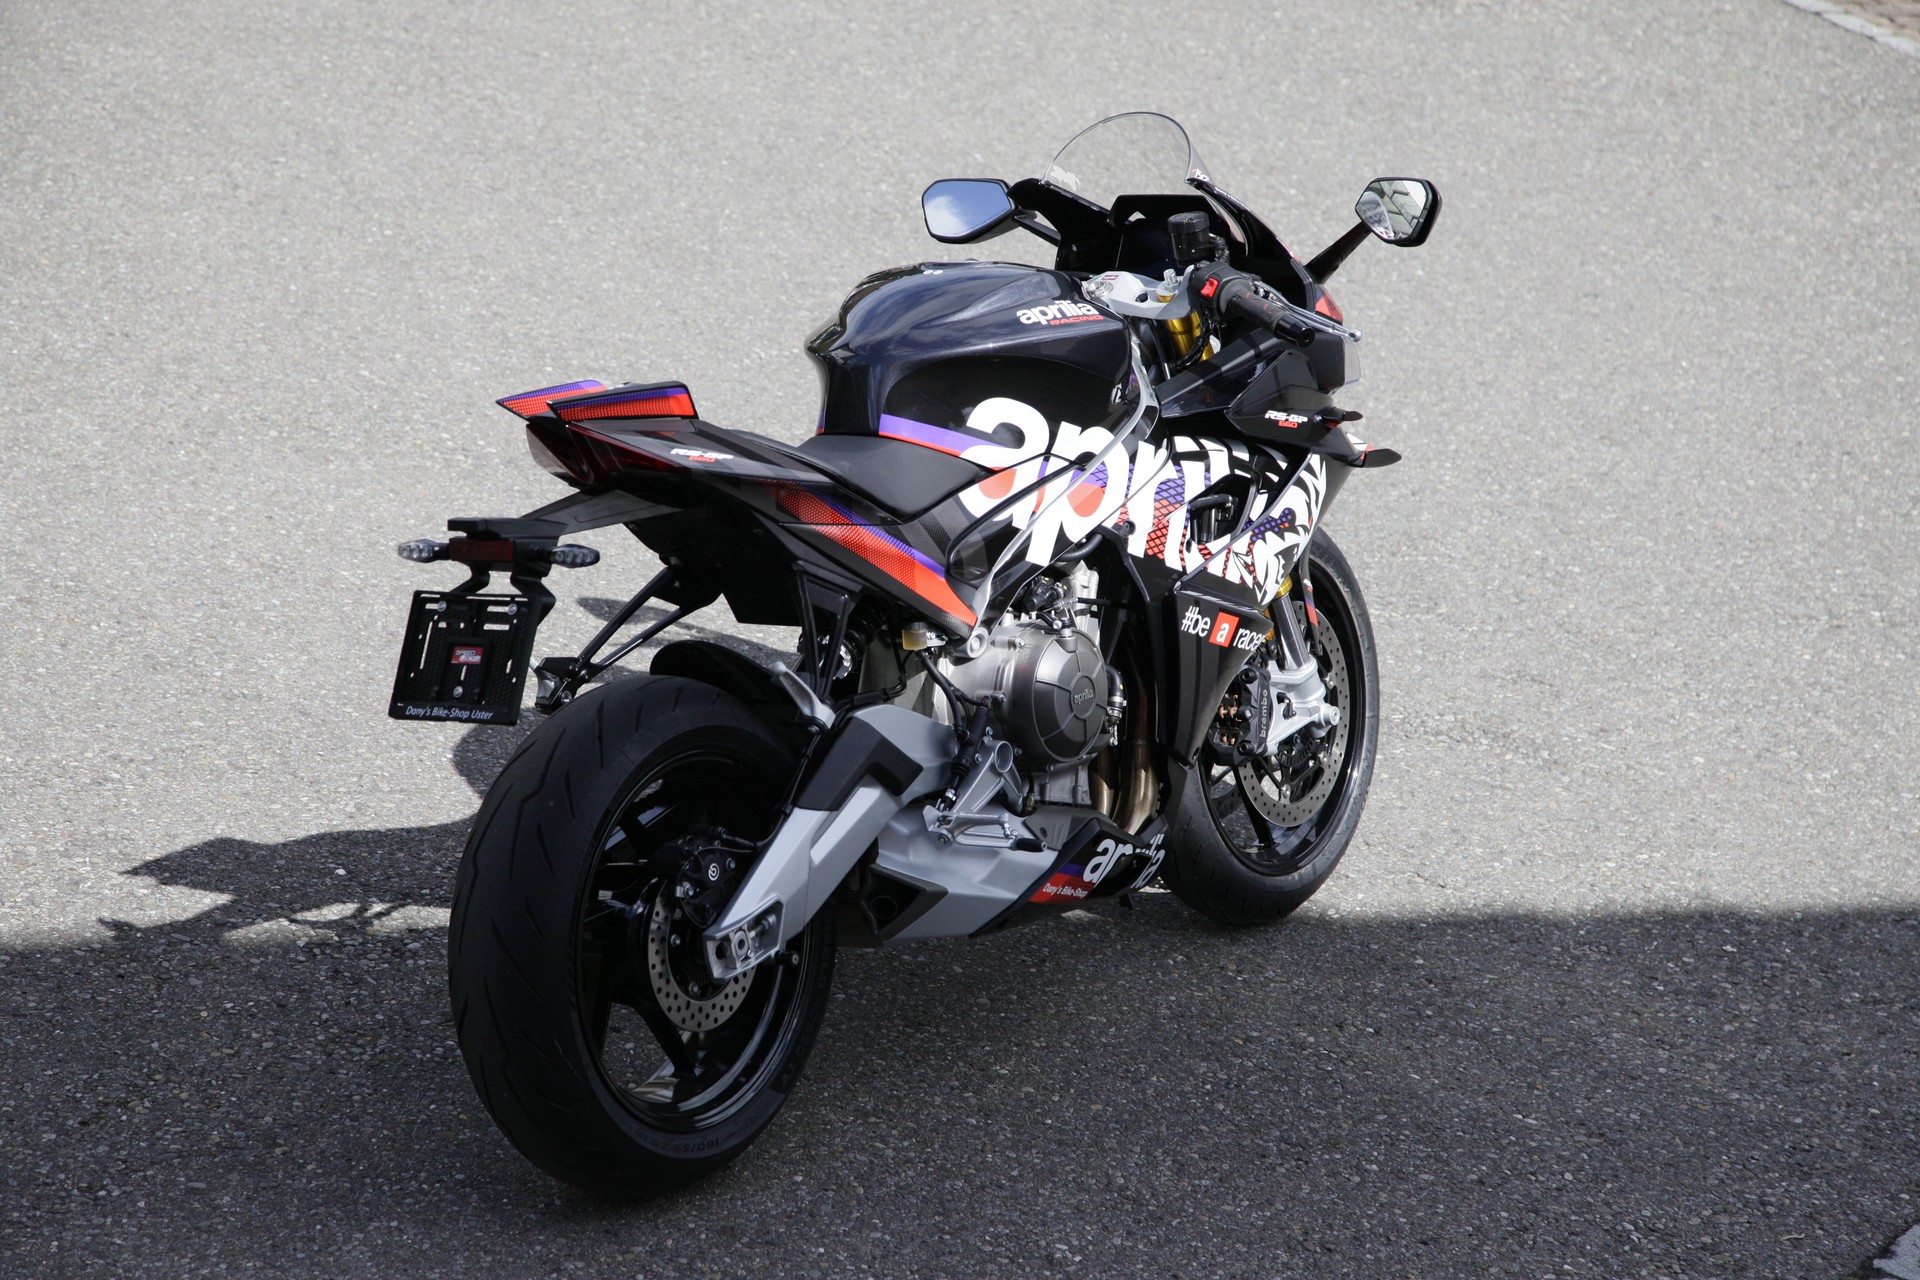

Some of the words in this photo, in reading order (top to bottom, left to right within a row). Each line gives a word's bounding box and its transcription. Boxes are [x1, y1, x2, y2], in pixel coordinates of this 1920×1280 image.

[1016, 300, 1099, 325] aprilia
[1050, 314, 1104, 326] RACING
[1264, 409, 1308, 423] RS-GP
[1278, 420, 1298, 428] 660
[1181, 605, 1211, 637] #be
[1216, 622, 1230, 644] a
[1074, 688, 1094, 705] aprilia
[405, 705, 431, 717] Dany's
[431, 707, 470, 720] Bike-Shop
[471, 709, 493, 719] Uster
[1260, 689, 1268, 738] brembo
[1042, 882, 1063, 896] Dany's
